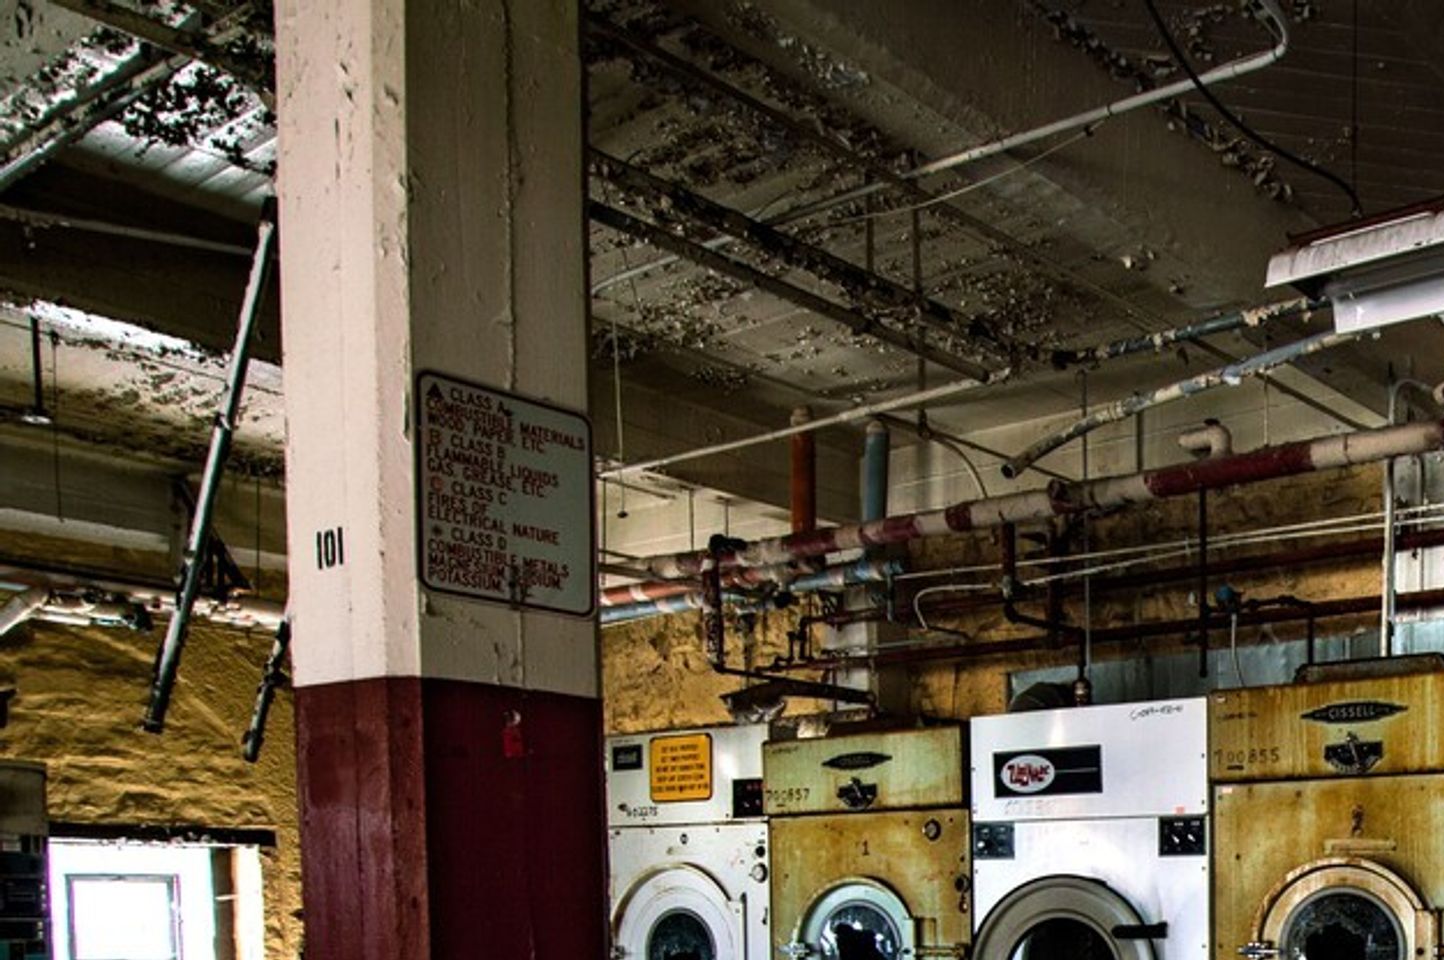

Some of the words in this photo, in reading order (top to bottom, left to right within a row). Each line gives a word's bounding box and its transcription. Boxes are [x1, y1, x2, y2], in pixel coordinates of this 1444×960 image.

[451, 387, 492, 411] CLASS
[451, 433, 492, 456] CLASS
[520, 422, 585, 451] MATERIALS
[427, 444, 505, 473] FLAMMABLE
[510, 464, 559, 488] LIQUIDS
[428, 490, 467, 513] FIRES
[471, 501, 488, 515] OF
[451, 481, 493, 503] CLASS
[498, 492, 508, 505] C
[428, 504, 506, 534] ELECTRICAL
[513, 523, 560, 546] NATURE
[316, 527, 344, 570] 101
[451, 527, 493, 547] CLASS
[497, 536, 508, 551] D
[428, 538, 518, 567] COMBUSTIBLE
[522, 556, 569, 578] METALS
[1328, 706, 1377, 720] CISSELL
[1213, 747, 1281, 765] 700855
